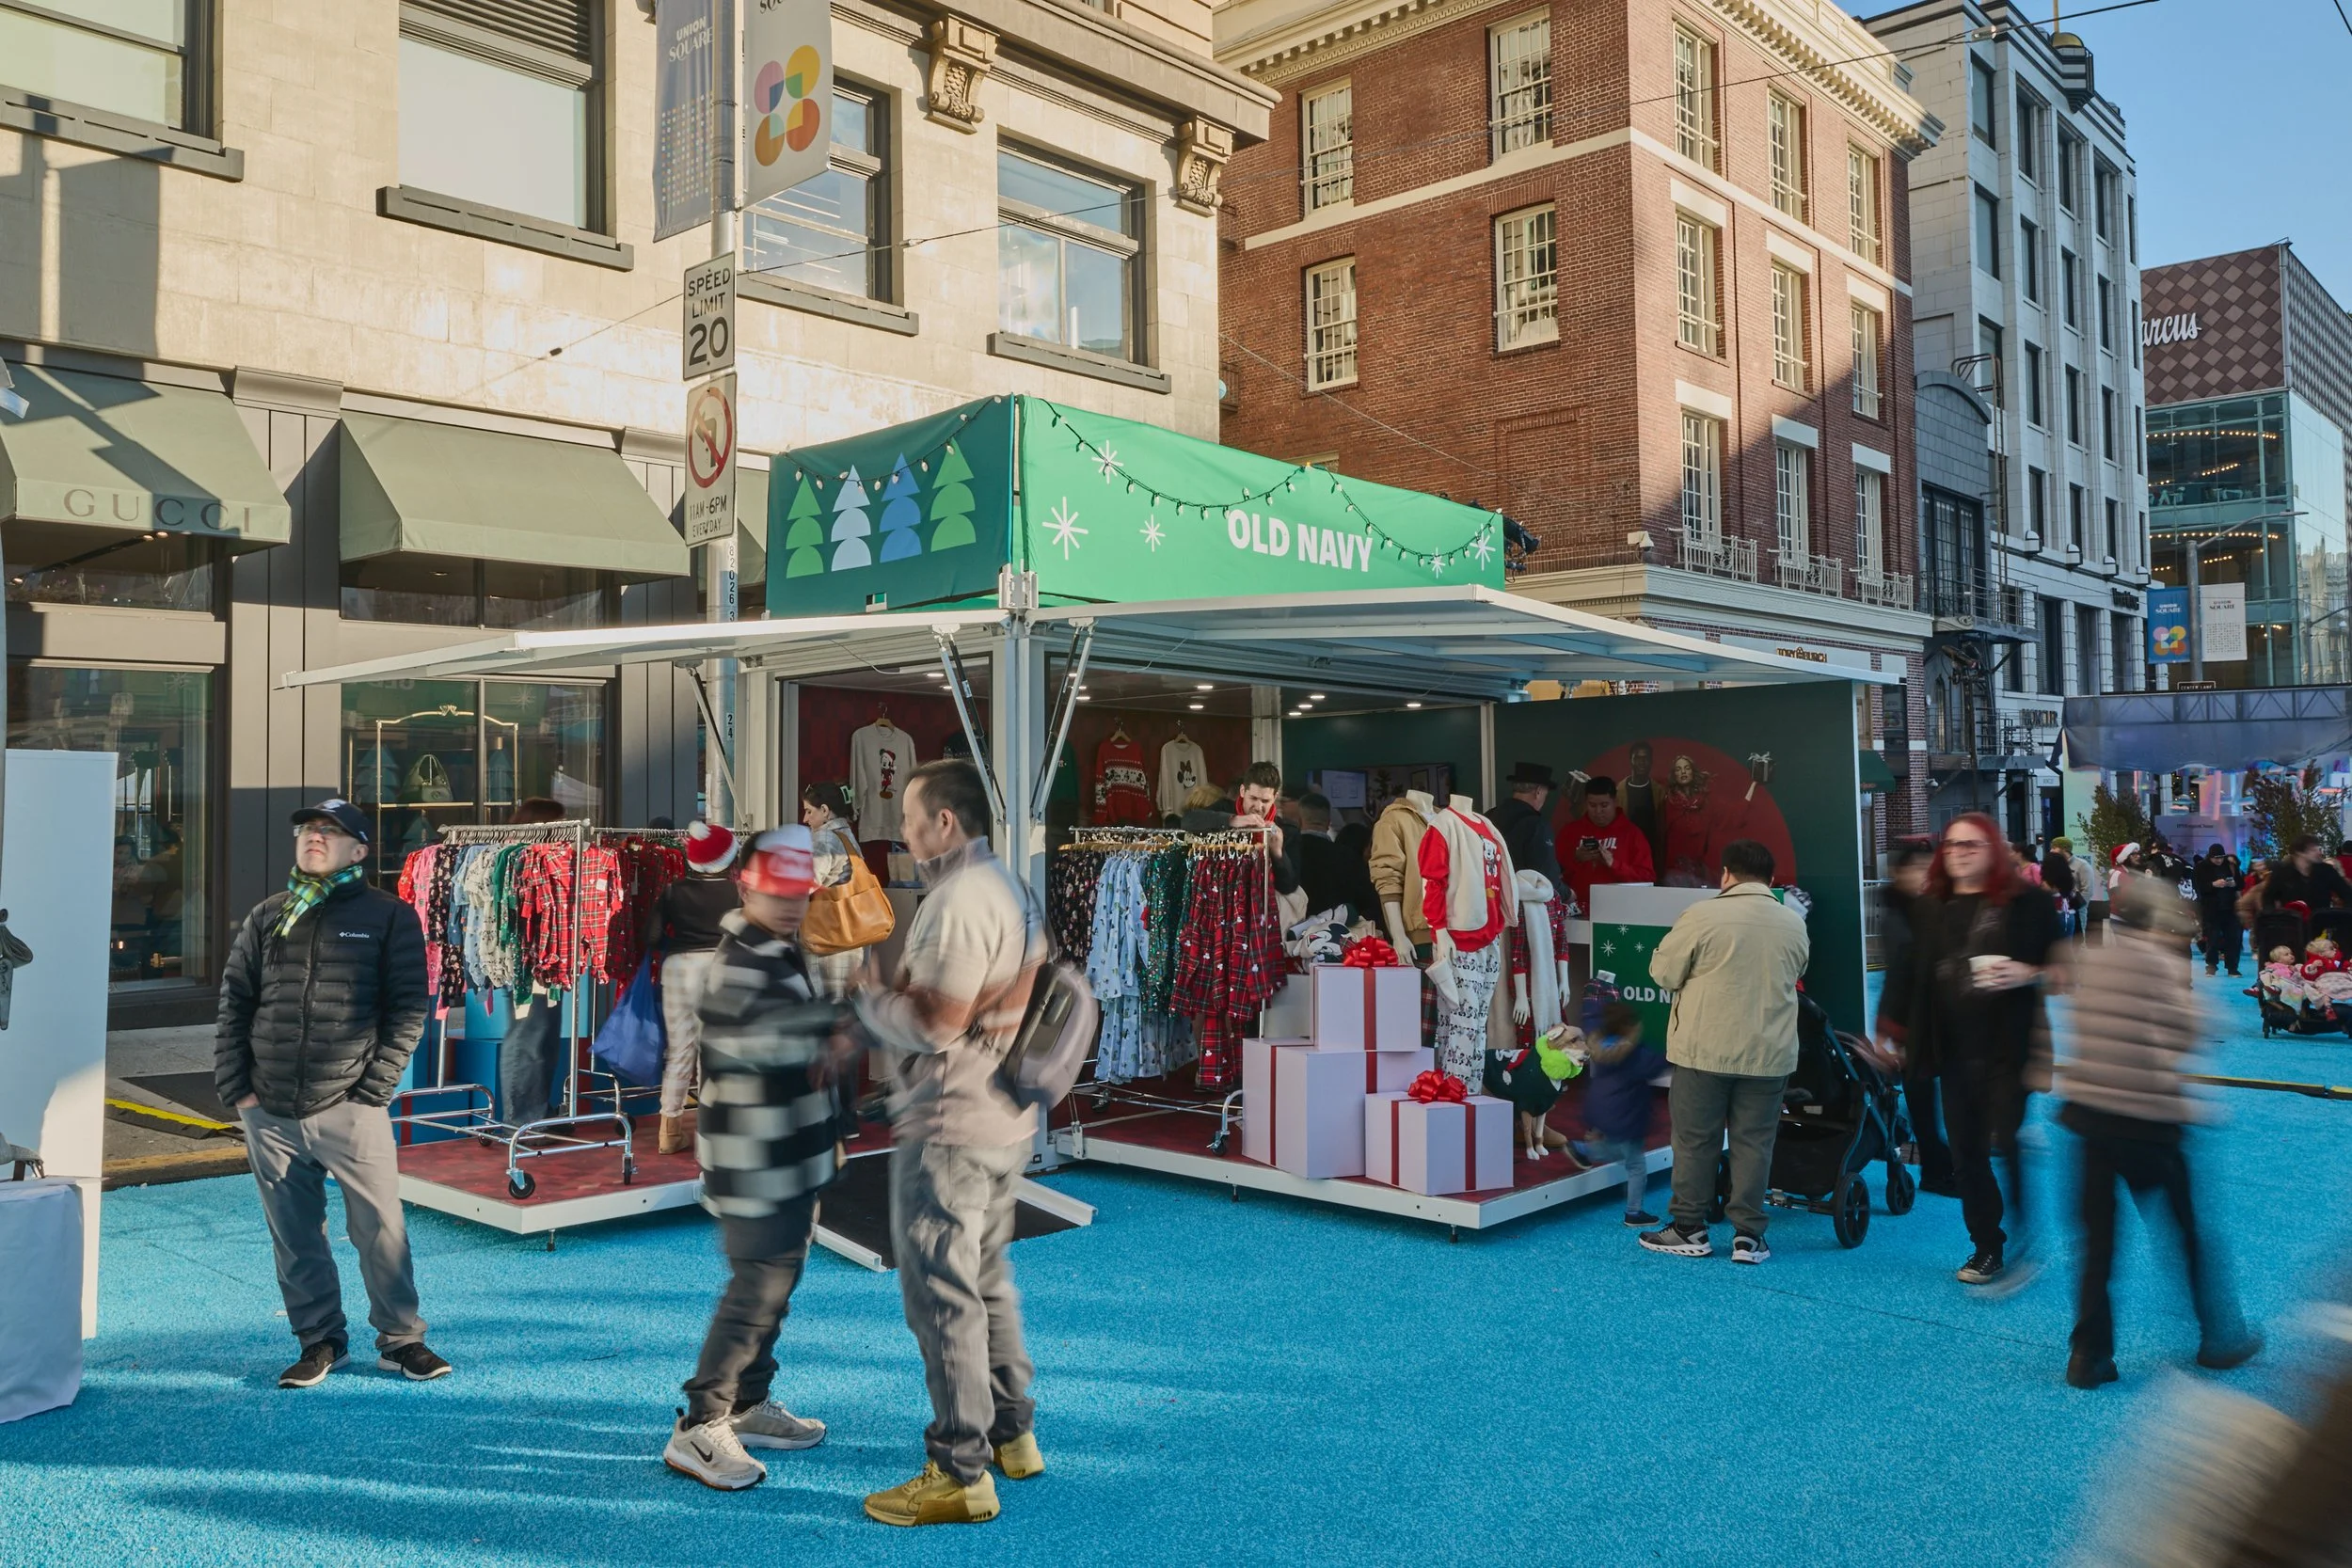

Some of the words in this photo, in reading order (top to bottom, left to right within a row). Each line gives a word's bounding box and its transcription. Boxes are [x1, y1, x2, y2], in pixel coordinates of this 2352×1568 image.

[669, 25, 715, 62] SQUARE
[676, 16, 707, 41] UNION
[688, 268, 731, 297] SPEED
[691, 292, 726, 319] LIMIT
[689, 316, 729, 366] 20
[63, 488, 250, 533] GUCCI
[1228, 509, 1290, 557] OLD
[1297, 523, 1374, 573] NAVY
[1623, 986, 1656, 1002] OLD
